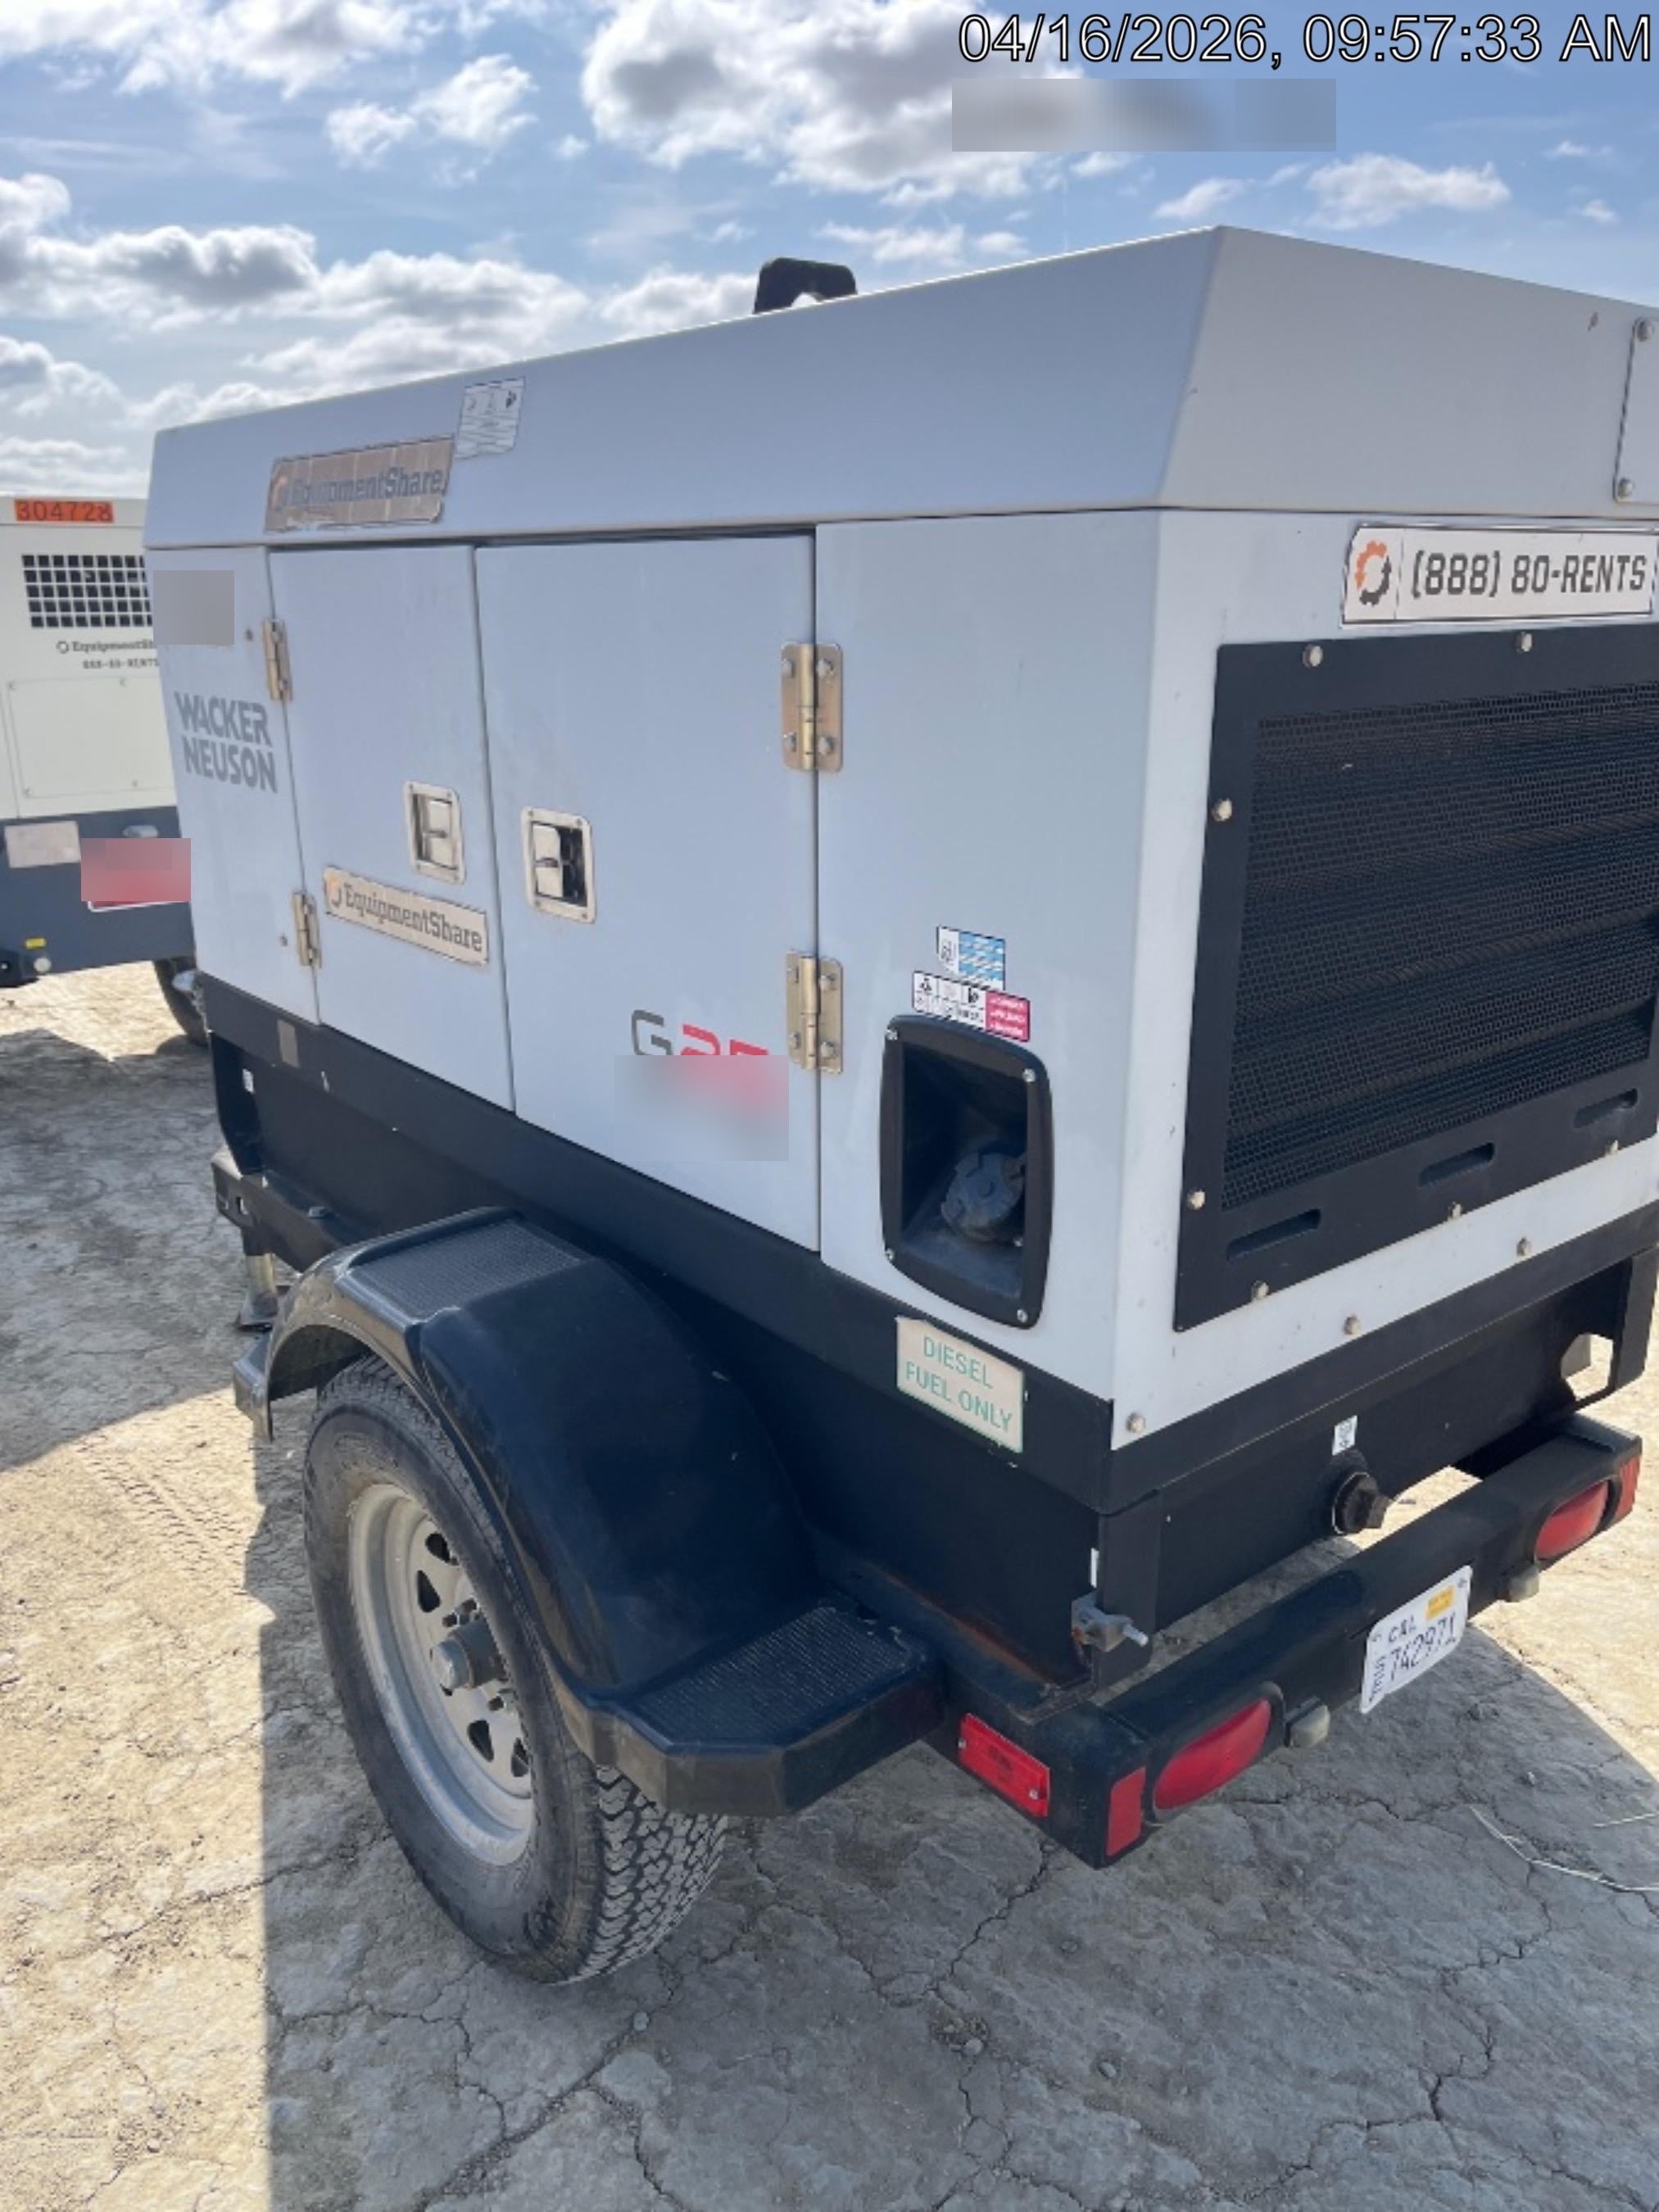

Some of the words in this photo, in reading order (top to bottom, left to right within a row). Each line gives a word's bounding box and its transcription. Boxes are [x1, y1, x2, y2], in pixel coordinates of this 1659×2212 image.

[16, 501, 114, 523] 304728
[1412, 550, 1501, 599] (888)
[1511, 555, 1647, 594] 80-RENTS
[174, 691, 274, 749] WACKER
[182, 735, 279, 794] NEUSON
[343, 882, 483, 953] EquipmentShare
[924, 1336, 994, 1389] DIESEL
[905, 1361, 952, 1403] FUEL
[958, 1389, 1013, 1433] ONLY
